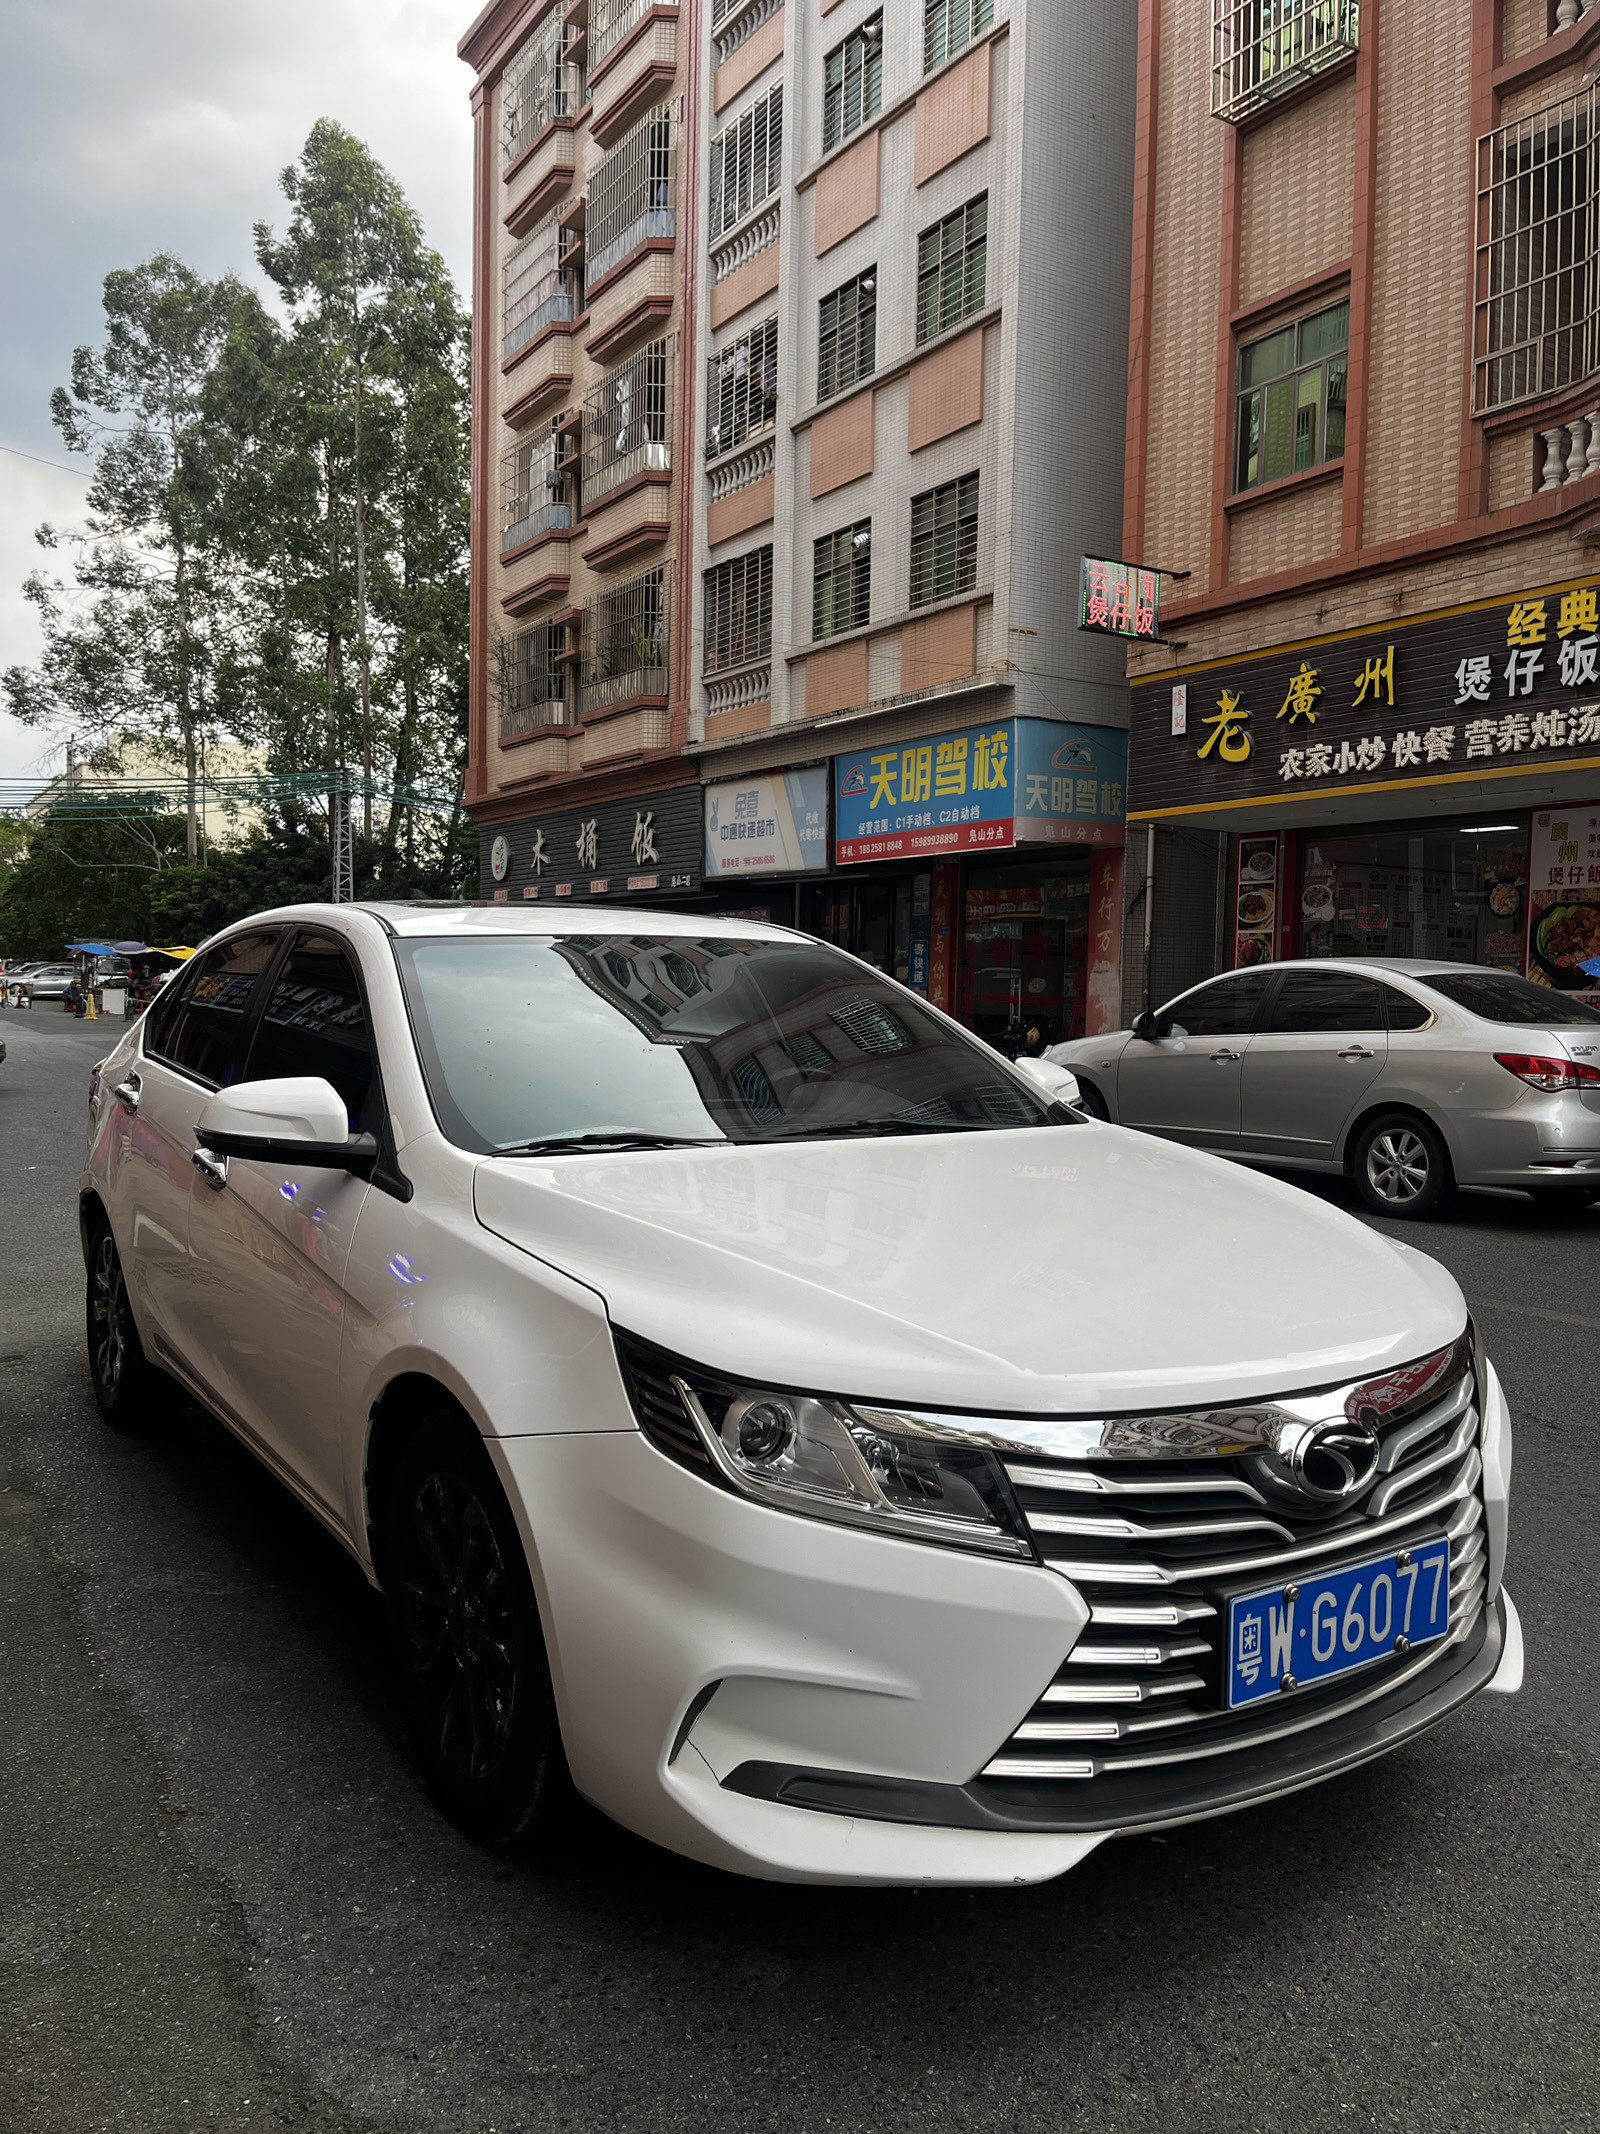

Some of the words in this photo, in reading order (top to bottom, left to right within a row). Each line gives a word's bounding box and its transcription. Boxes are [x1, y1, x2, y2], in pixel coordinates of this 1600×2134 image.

[1086, 595, 1154, 635] 煲仔饭
[1506, 589, 1600, 647] 经典
[1454, 634, 1600, 705] 煲仔饭
[869, 730, 1008, 810] 天明驾校
[1025, 774, 1122, 817] 天明驾校
[531, 811, 660, 876] 木桶饭
[720, 818, 775, 841] 中通快递超市
[1588, 817, 1600, 828] 现
[913, 943, 925, 983] 寄快递
